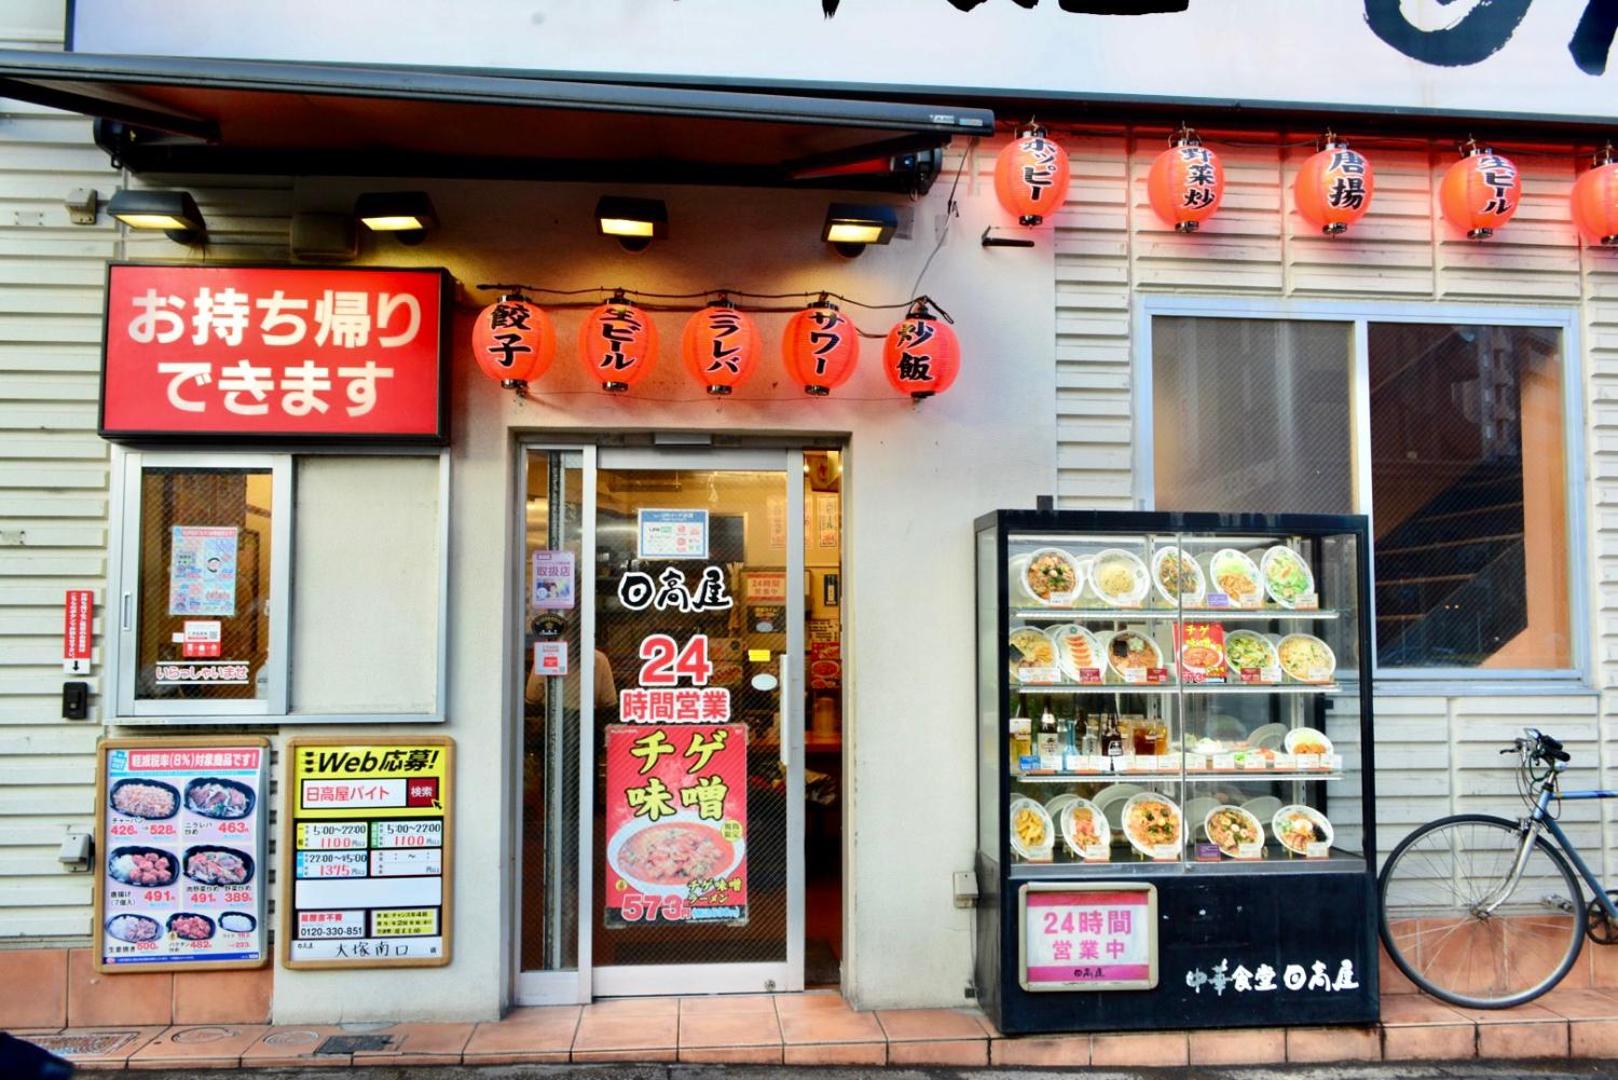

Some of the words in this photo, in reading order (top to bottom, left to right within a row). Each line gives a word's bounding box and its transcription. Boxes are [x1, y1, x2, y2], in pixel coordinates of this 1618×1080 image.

[1023, 138, 1056, 200] ホッピー
[1180, 148, 1215, 209] 野菜炒
[1328, 151, 1365, 210] 唐揚
[1477, 156, 1514, 215] 生ビール
[128, 287, 421, 348] お持ち帰り
[488, 303, 531, 367] 餃子
[600, 308, 642, 370] 生ビール
[706, 309, 741, 373] ニラレバ
[808, 311, 844, 375] サワー
[897, 321, 935, 382] 炒飯
[157, 359, 394, 417] できます
[618, 566, 733, 612] 日高屋
[155, 665, 249, 680] いらっしゃいませ
[639, 634, 713, 687] 24
[620, 688, 731, 723] 時間営業
[629, 728, 729, 776] チゲ
[306, 786, 390, 802] 日高屋バイト
[410, 786, 433, 798] 検索
[624, 773, 729, 821] 味噌
[336, 941, 409, 957] 大塚南口
[1043, 910, 1132, 935] 24時間
[1052, 939, 1126, 961] 営業中
